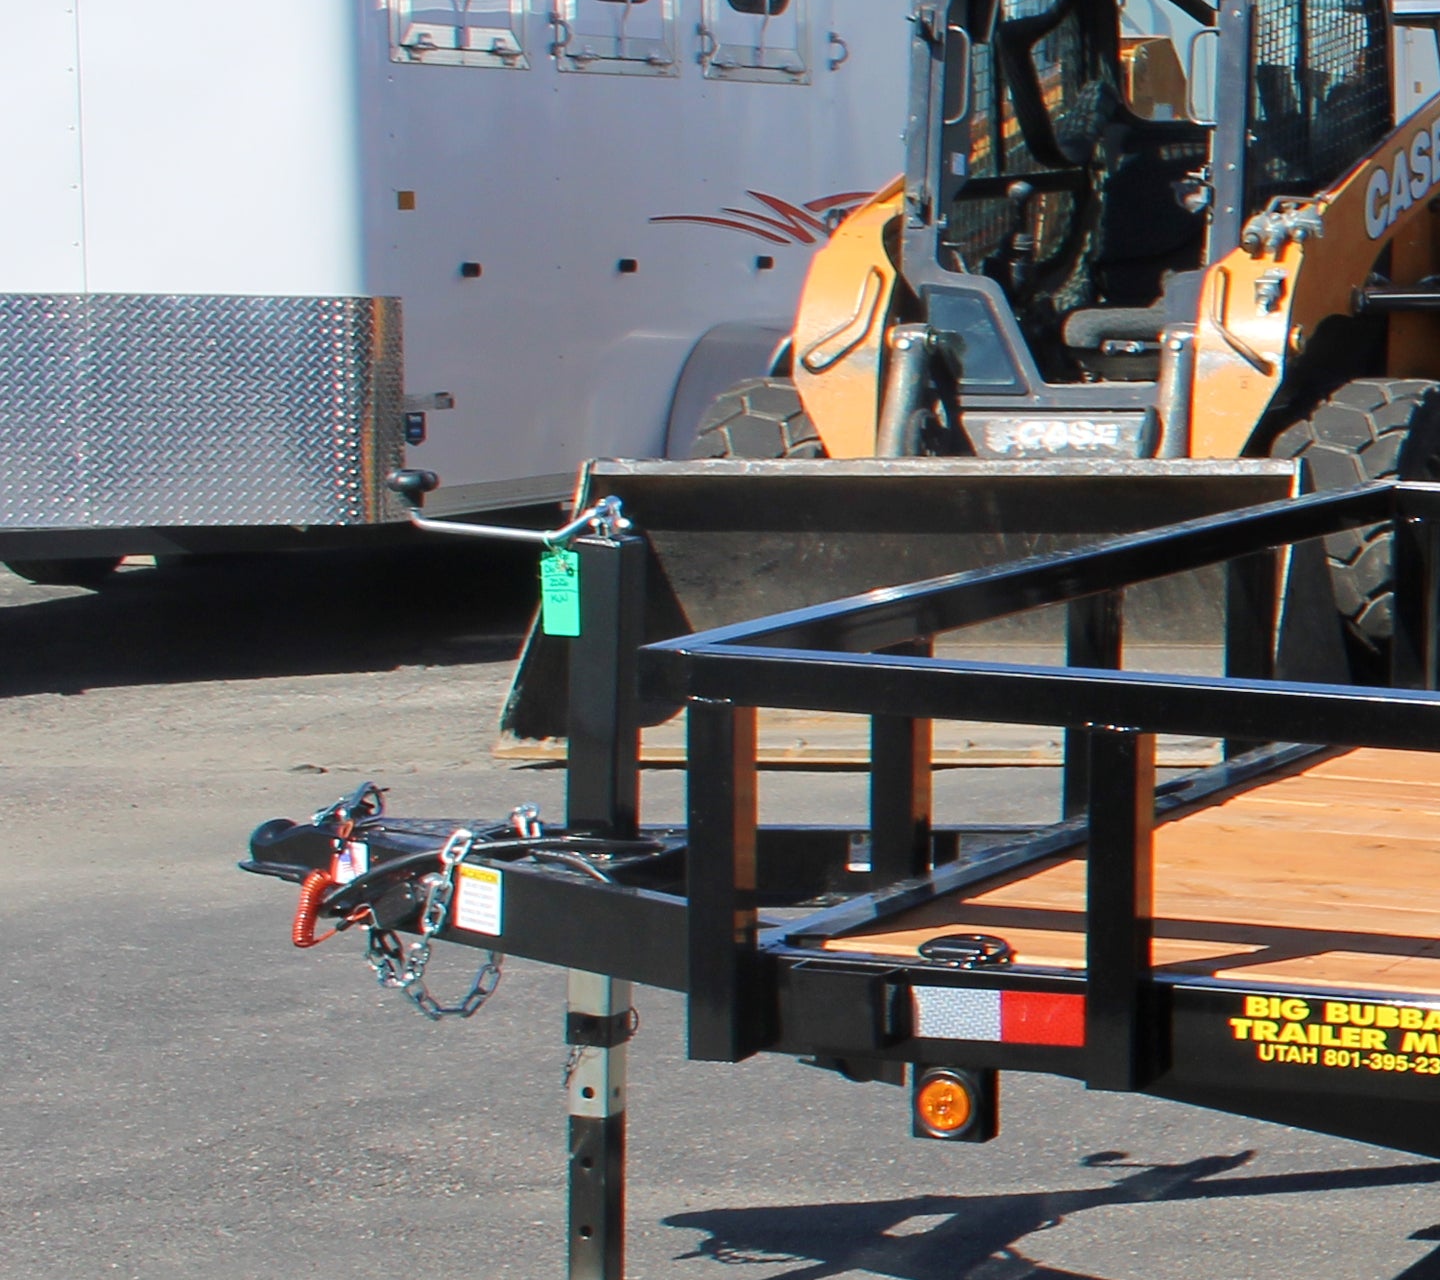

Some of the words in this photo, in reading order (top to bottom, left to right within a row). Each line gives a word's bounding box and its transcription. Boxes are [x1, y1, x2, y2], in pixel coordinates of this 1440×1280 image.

[1245, 996, 1309, 1020] BIG
[1230, 1018, 1387, 1050] TRAILER
[1258, 1044, 1318, 1064] UTAH
